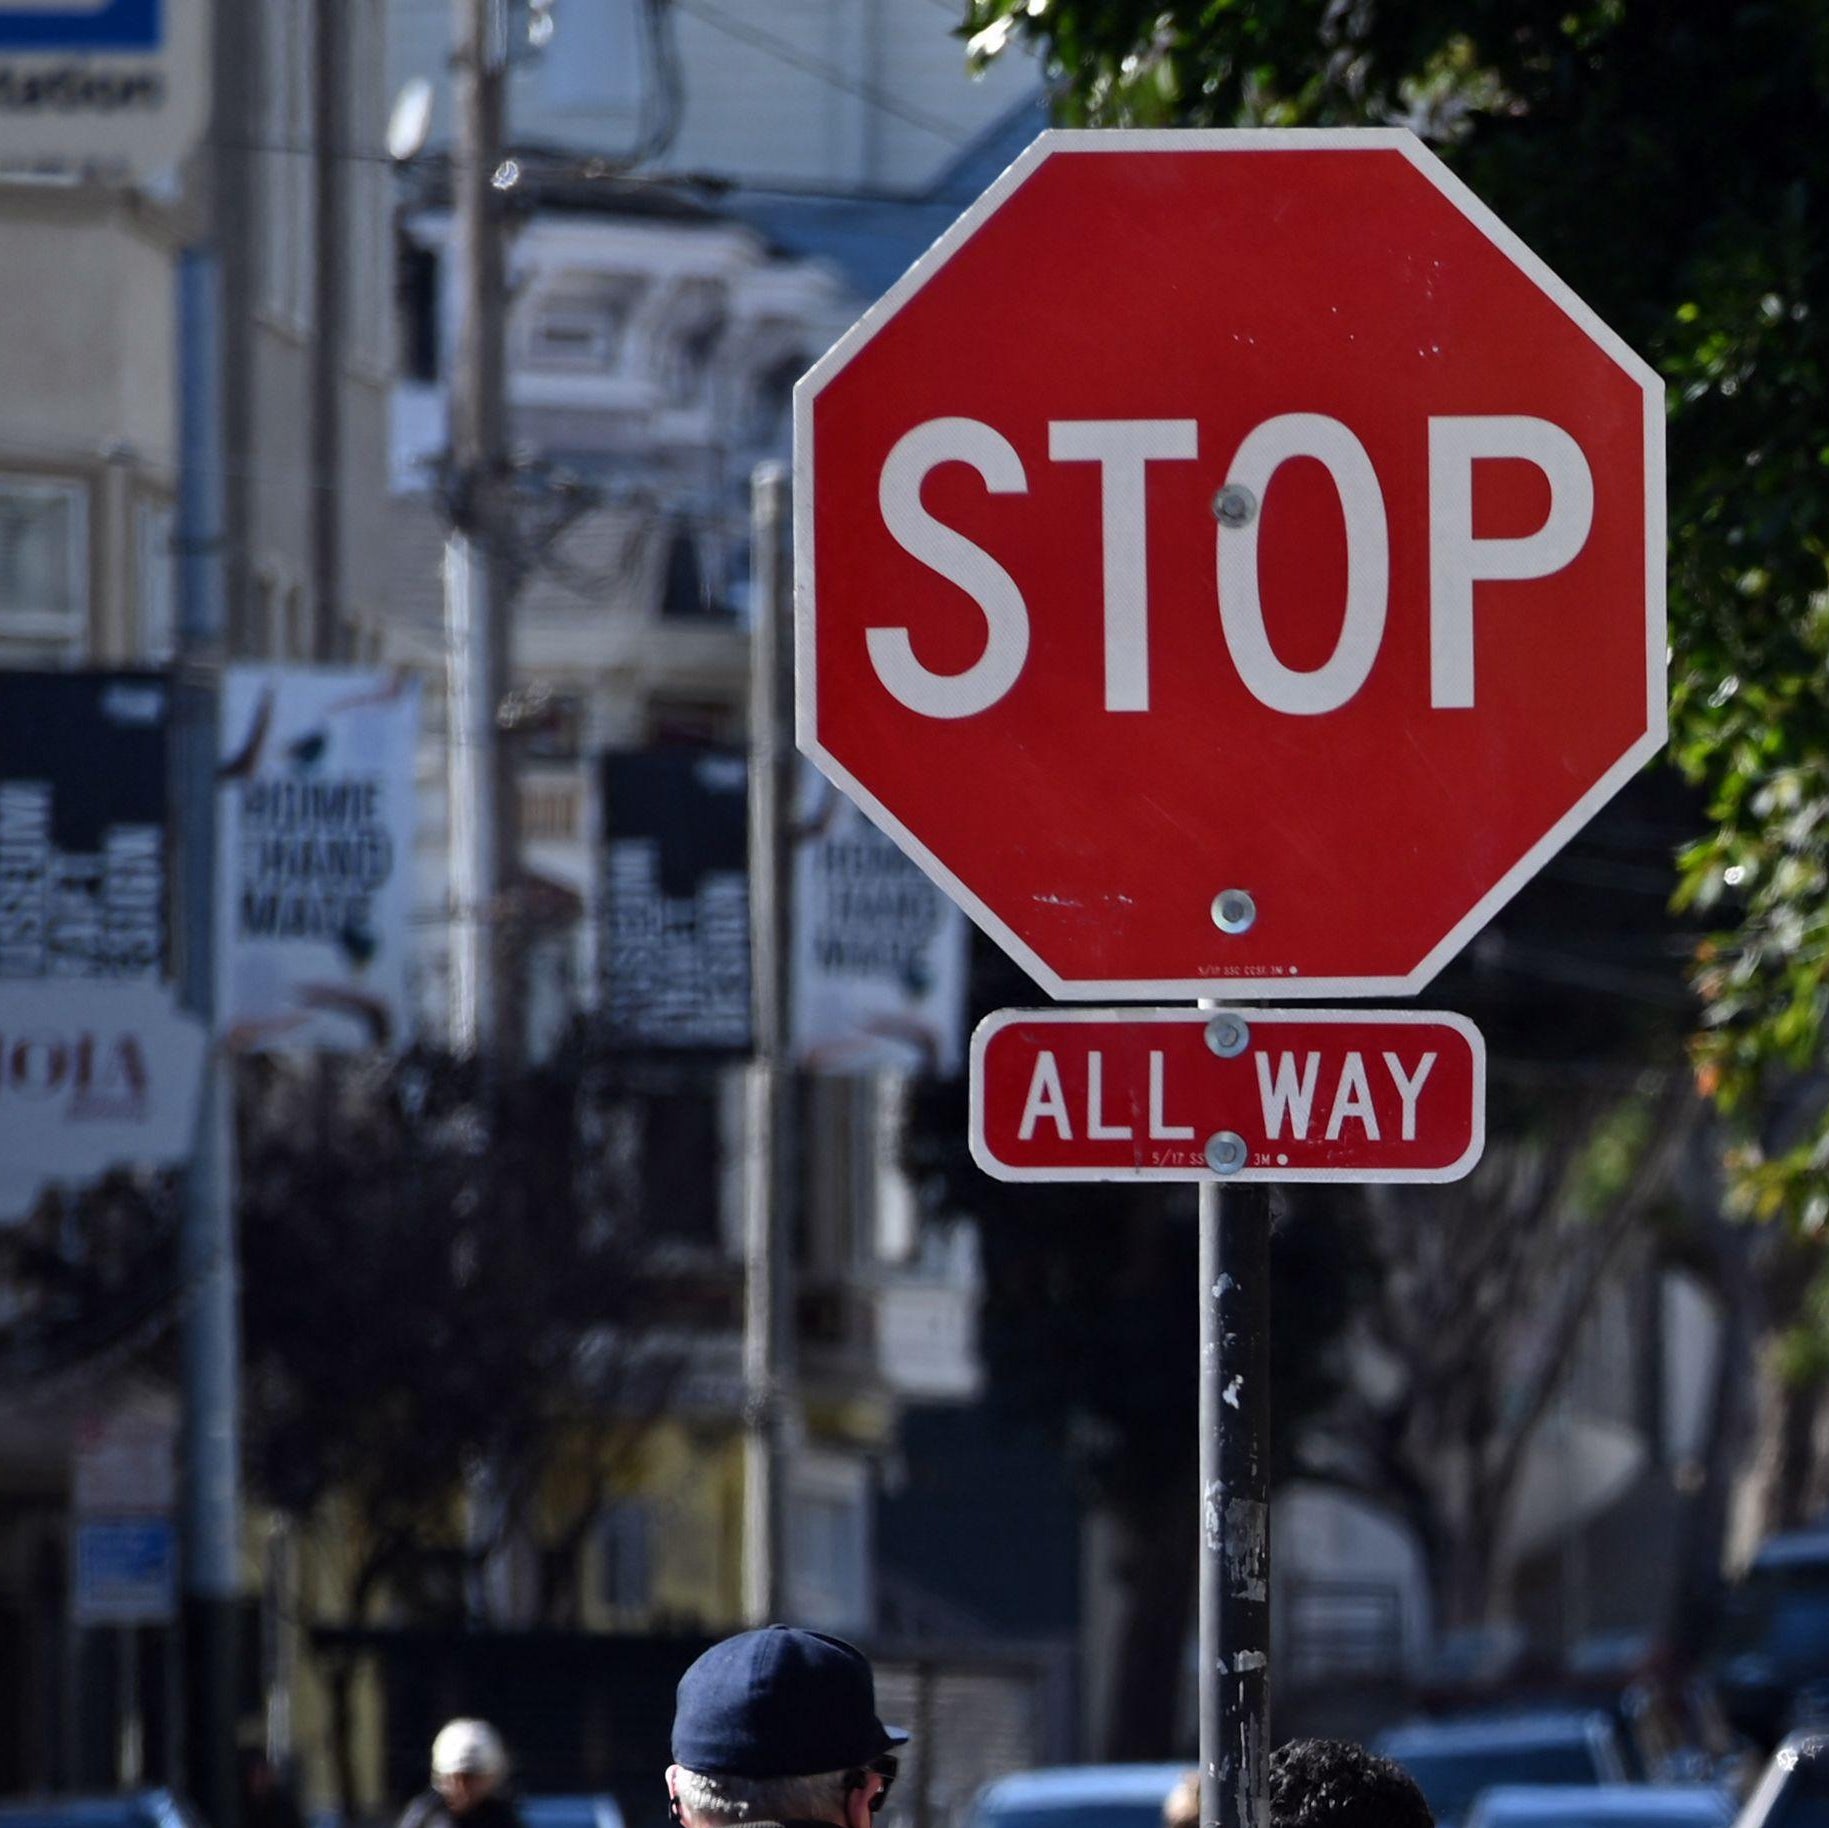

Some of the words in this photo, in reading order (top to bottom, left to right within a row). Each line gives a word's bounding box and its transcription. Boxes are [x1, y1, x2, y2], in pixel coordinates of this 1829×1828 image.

[865, 412, 1594, 718] STOP
[1018, 1051, 1195, 1140] ALL
[1254, 1052, 1437, 1141] WAY
[1152, 1150, 1184, 1166] 5/17
[1254, 1153, 1270, 1165] 3M
